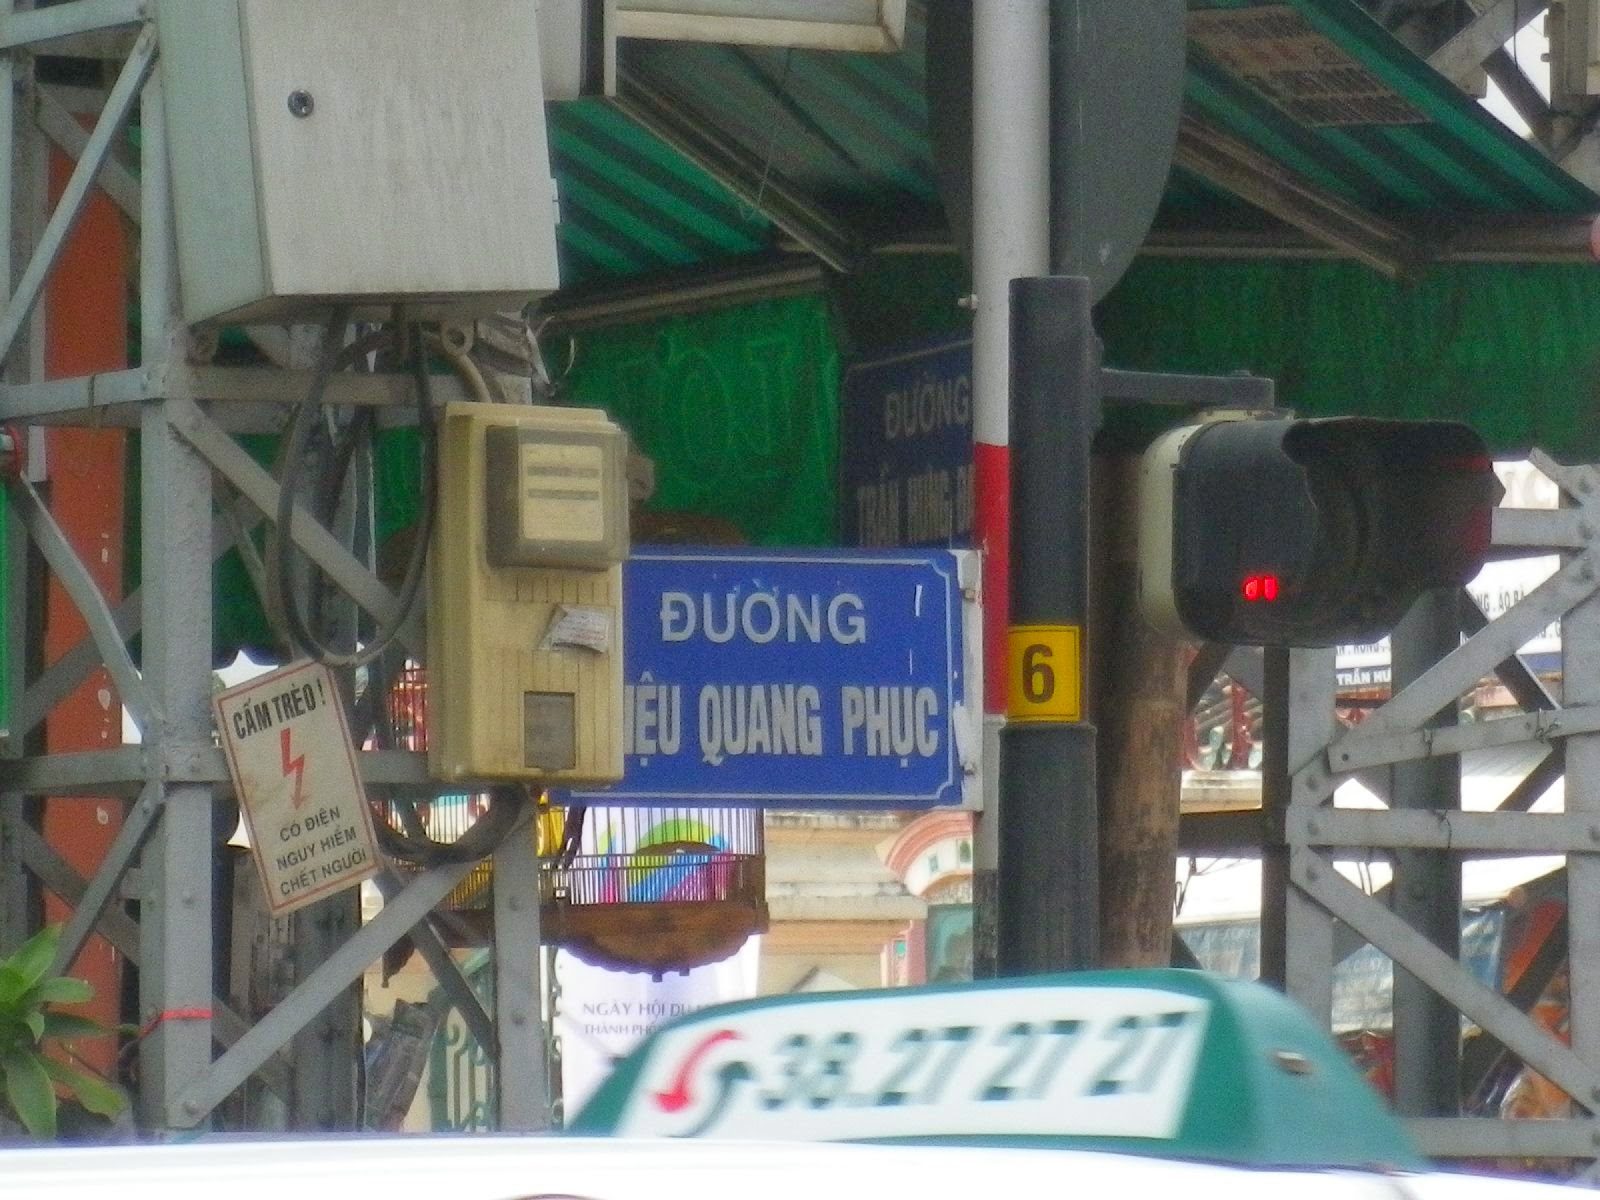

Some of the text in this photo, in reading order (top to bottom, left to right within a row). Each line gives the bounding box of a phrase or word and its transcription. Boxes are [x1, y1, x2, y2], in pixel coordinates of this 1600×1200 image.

[660, 578, 867, 645] ĐƯỜNG
[1022, 643, 1055, 704] 6
[233, 697, 272, 739] CẤM
[699, 684, 823, 767] QUANG
[841, 686, 938, 768] PHỤC
[276, 824, 357, 871] NGUY HIỂM
[279, 806, 341, 842] CÓ ĐIỆN
[280, 848, 367, 896] CHẾT NGƯỜI
[583, 999, 632, 1017] NGÀY
